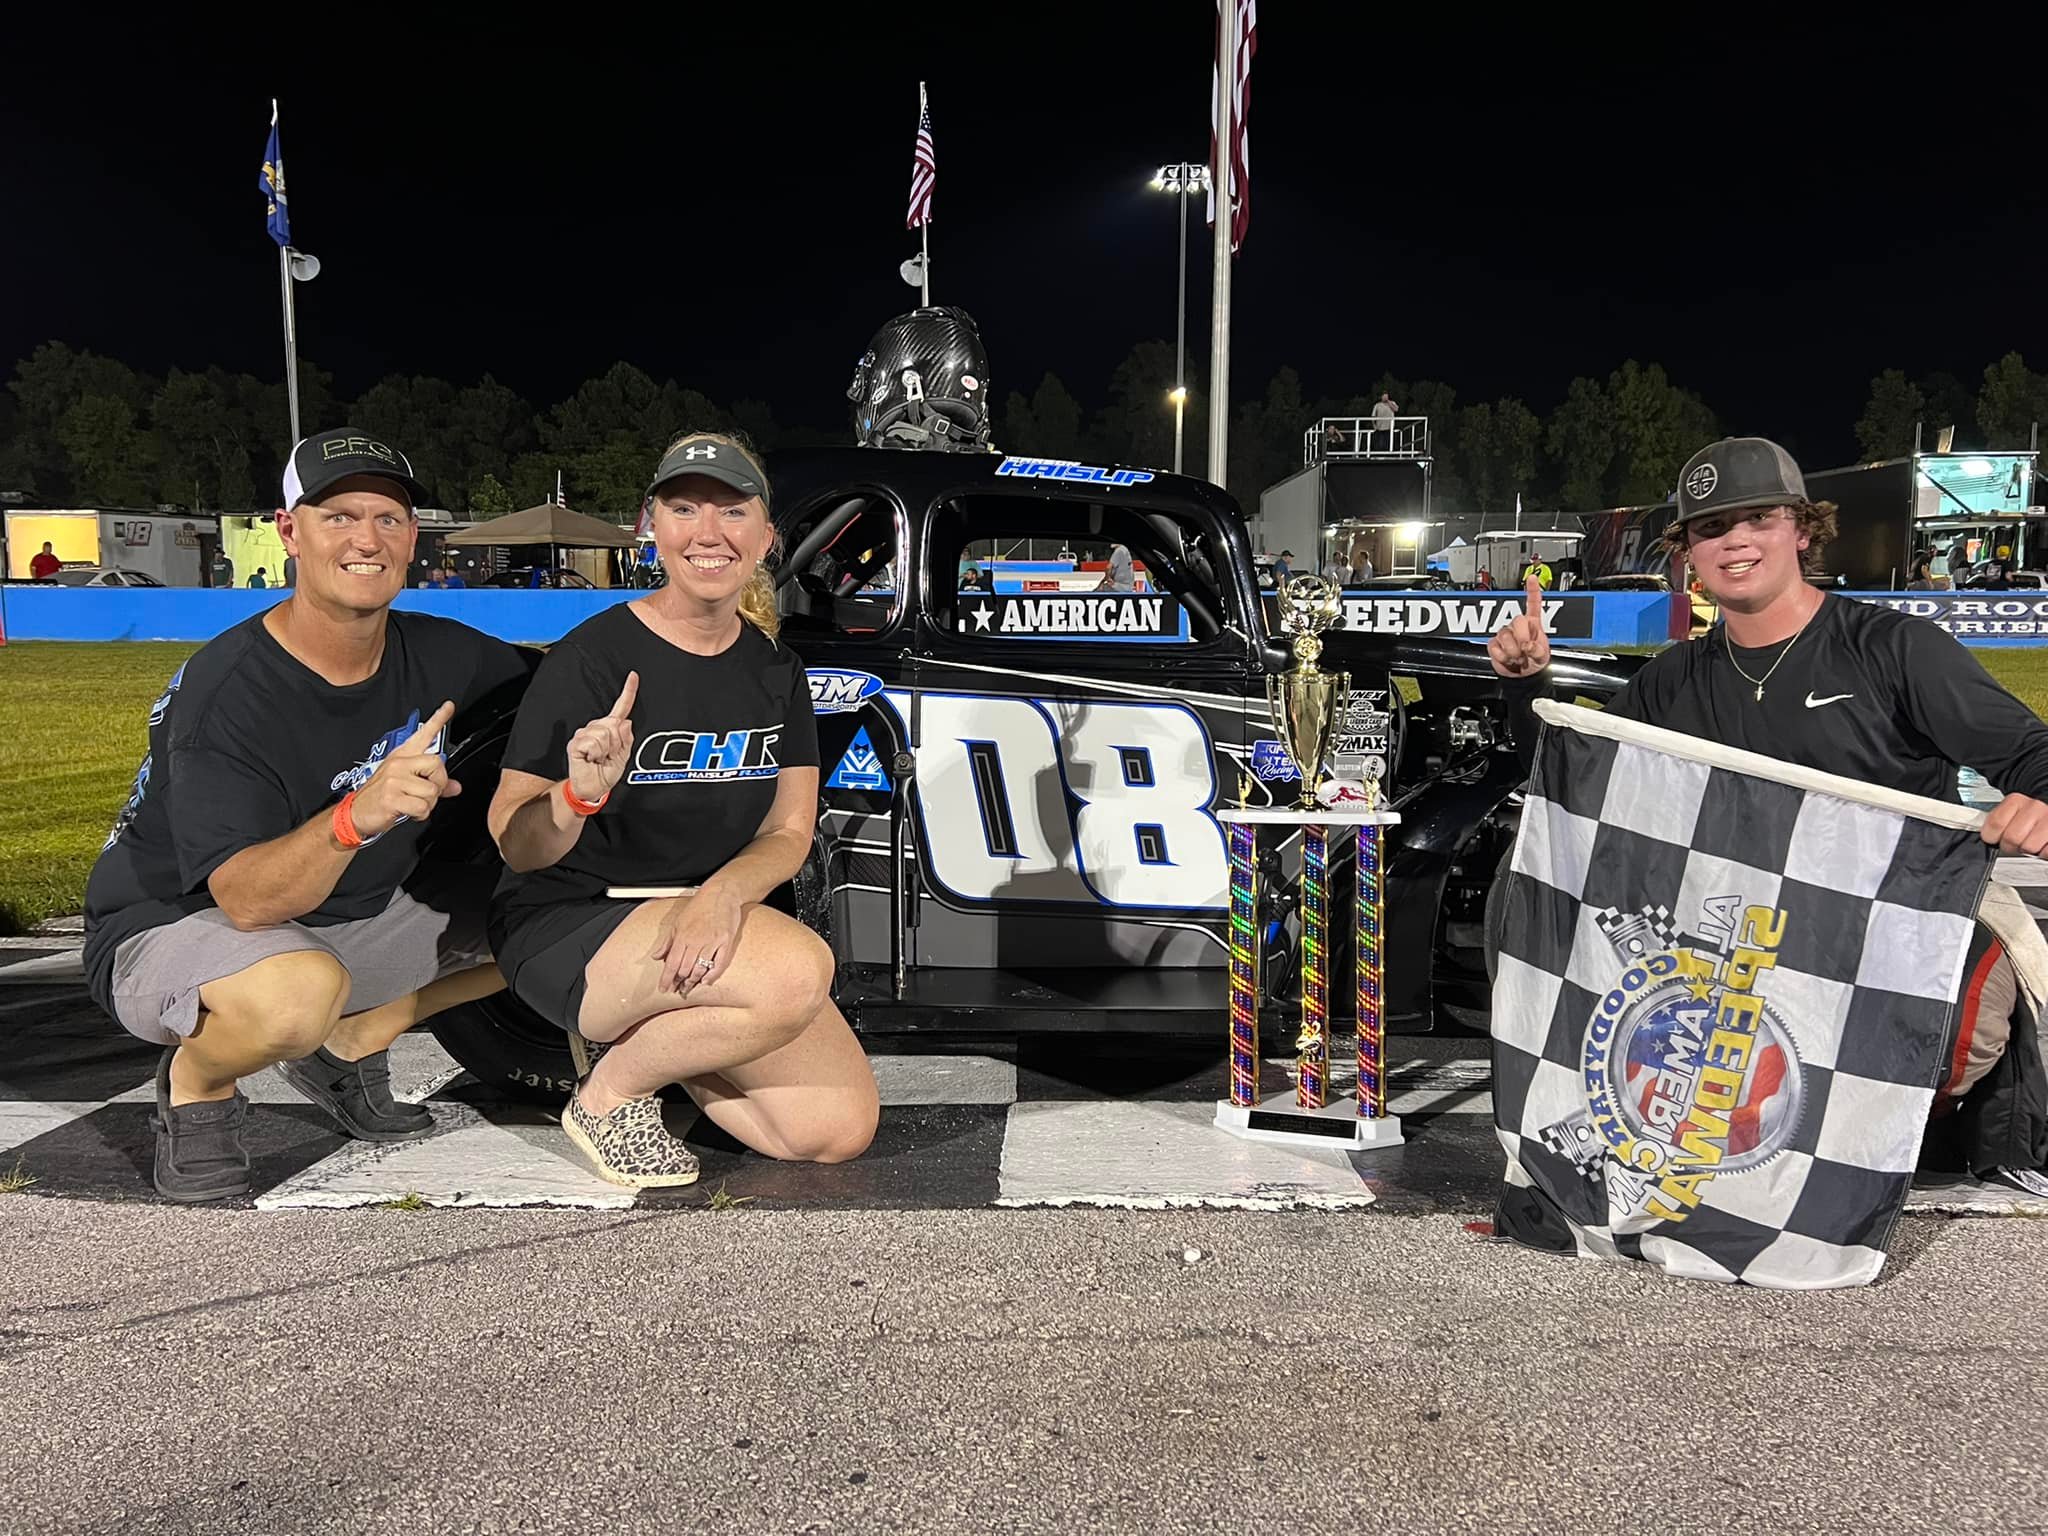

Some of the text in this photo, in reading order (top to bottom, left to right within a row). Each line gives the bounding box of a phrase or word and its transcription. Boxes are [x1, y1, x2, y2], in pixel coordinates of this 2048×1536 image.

[995, 461, 1156, 487] HAISLIP
[126, 521, 152, 546] 18
[1000, 599, 1162, 632] AMERICAN
[636, 724, 784, 771] CHR
[633, 772, 688, 781] CARSON
[688, 770, 738, 780] HAISLIP
[1260, 764, 1294, 778] Racing
[884, 690, 1232, 908] 08
